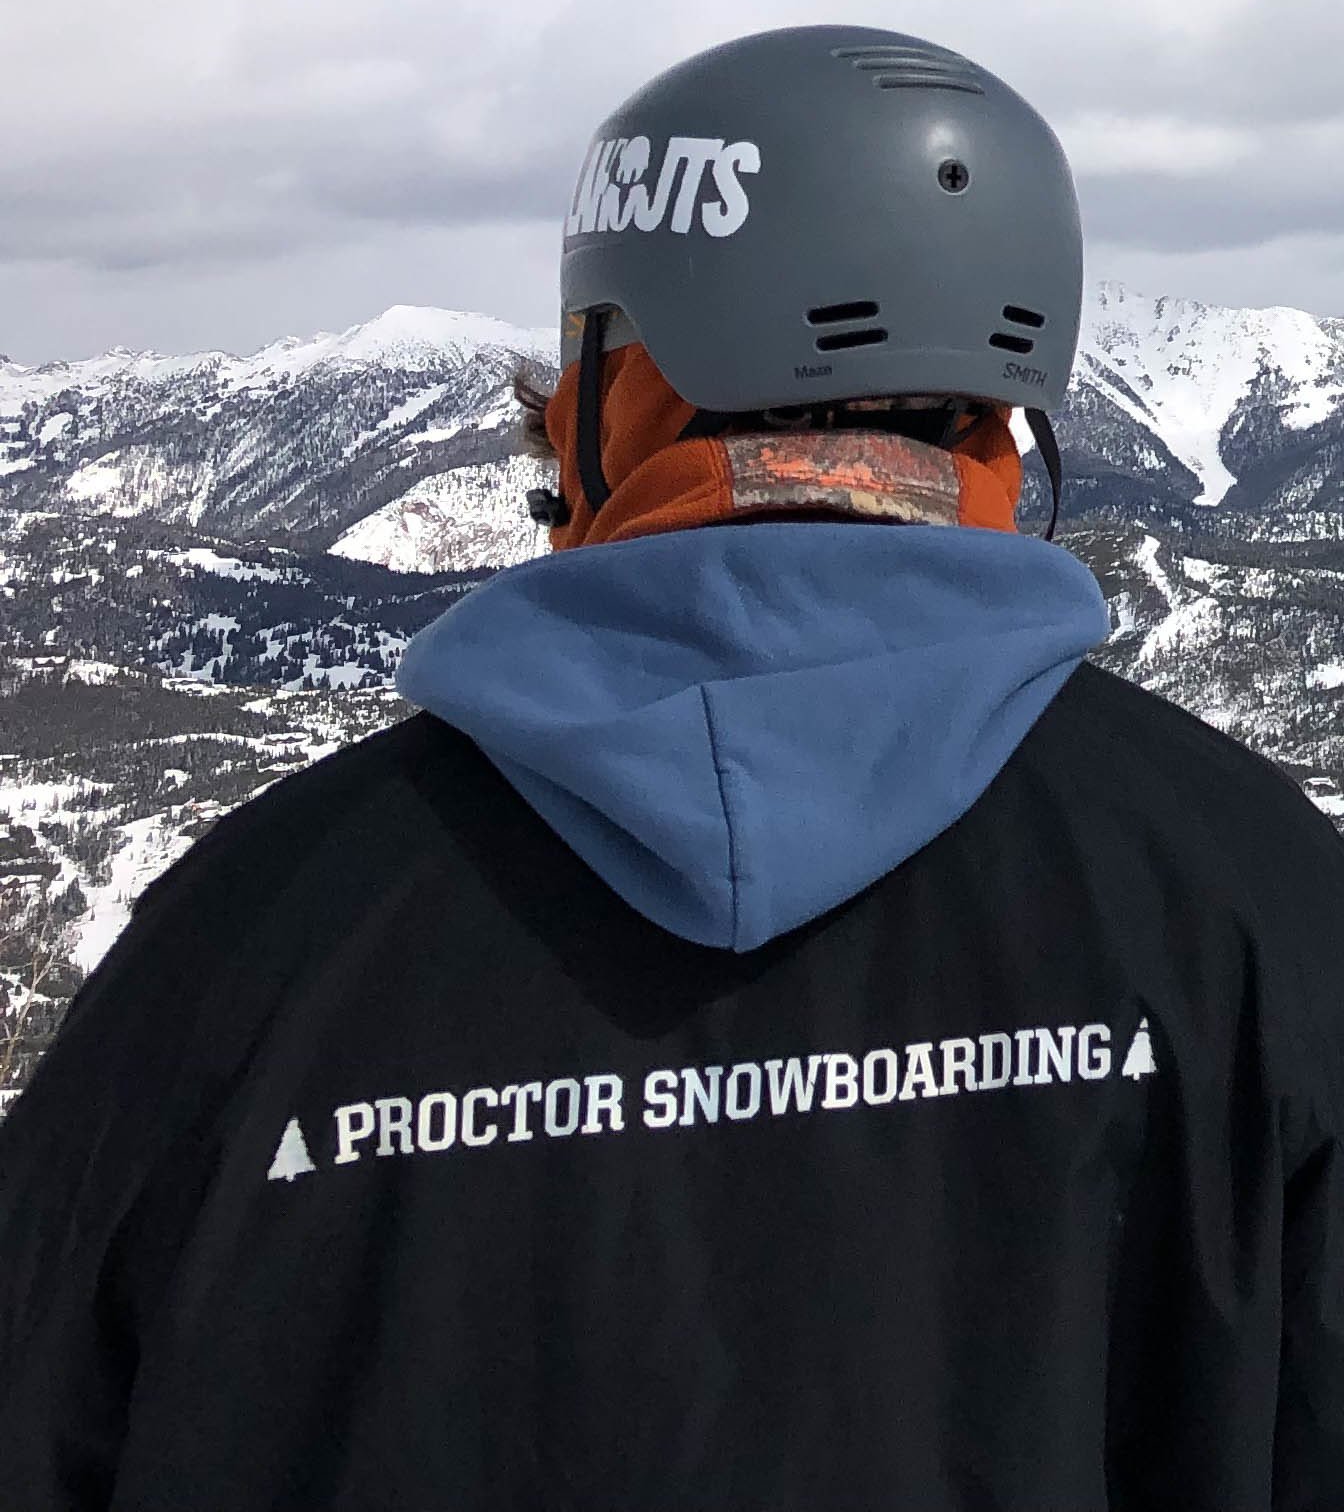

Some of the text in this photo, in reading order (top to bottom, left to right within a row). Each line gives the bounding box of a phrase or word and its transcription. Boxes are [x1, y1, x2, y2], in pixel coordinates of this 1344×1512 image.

[1003, 362, 1049, 388] SMITH
[334, 1023, 1112, 1165] PROCTOR SNOWBOARDING
